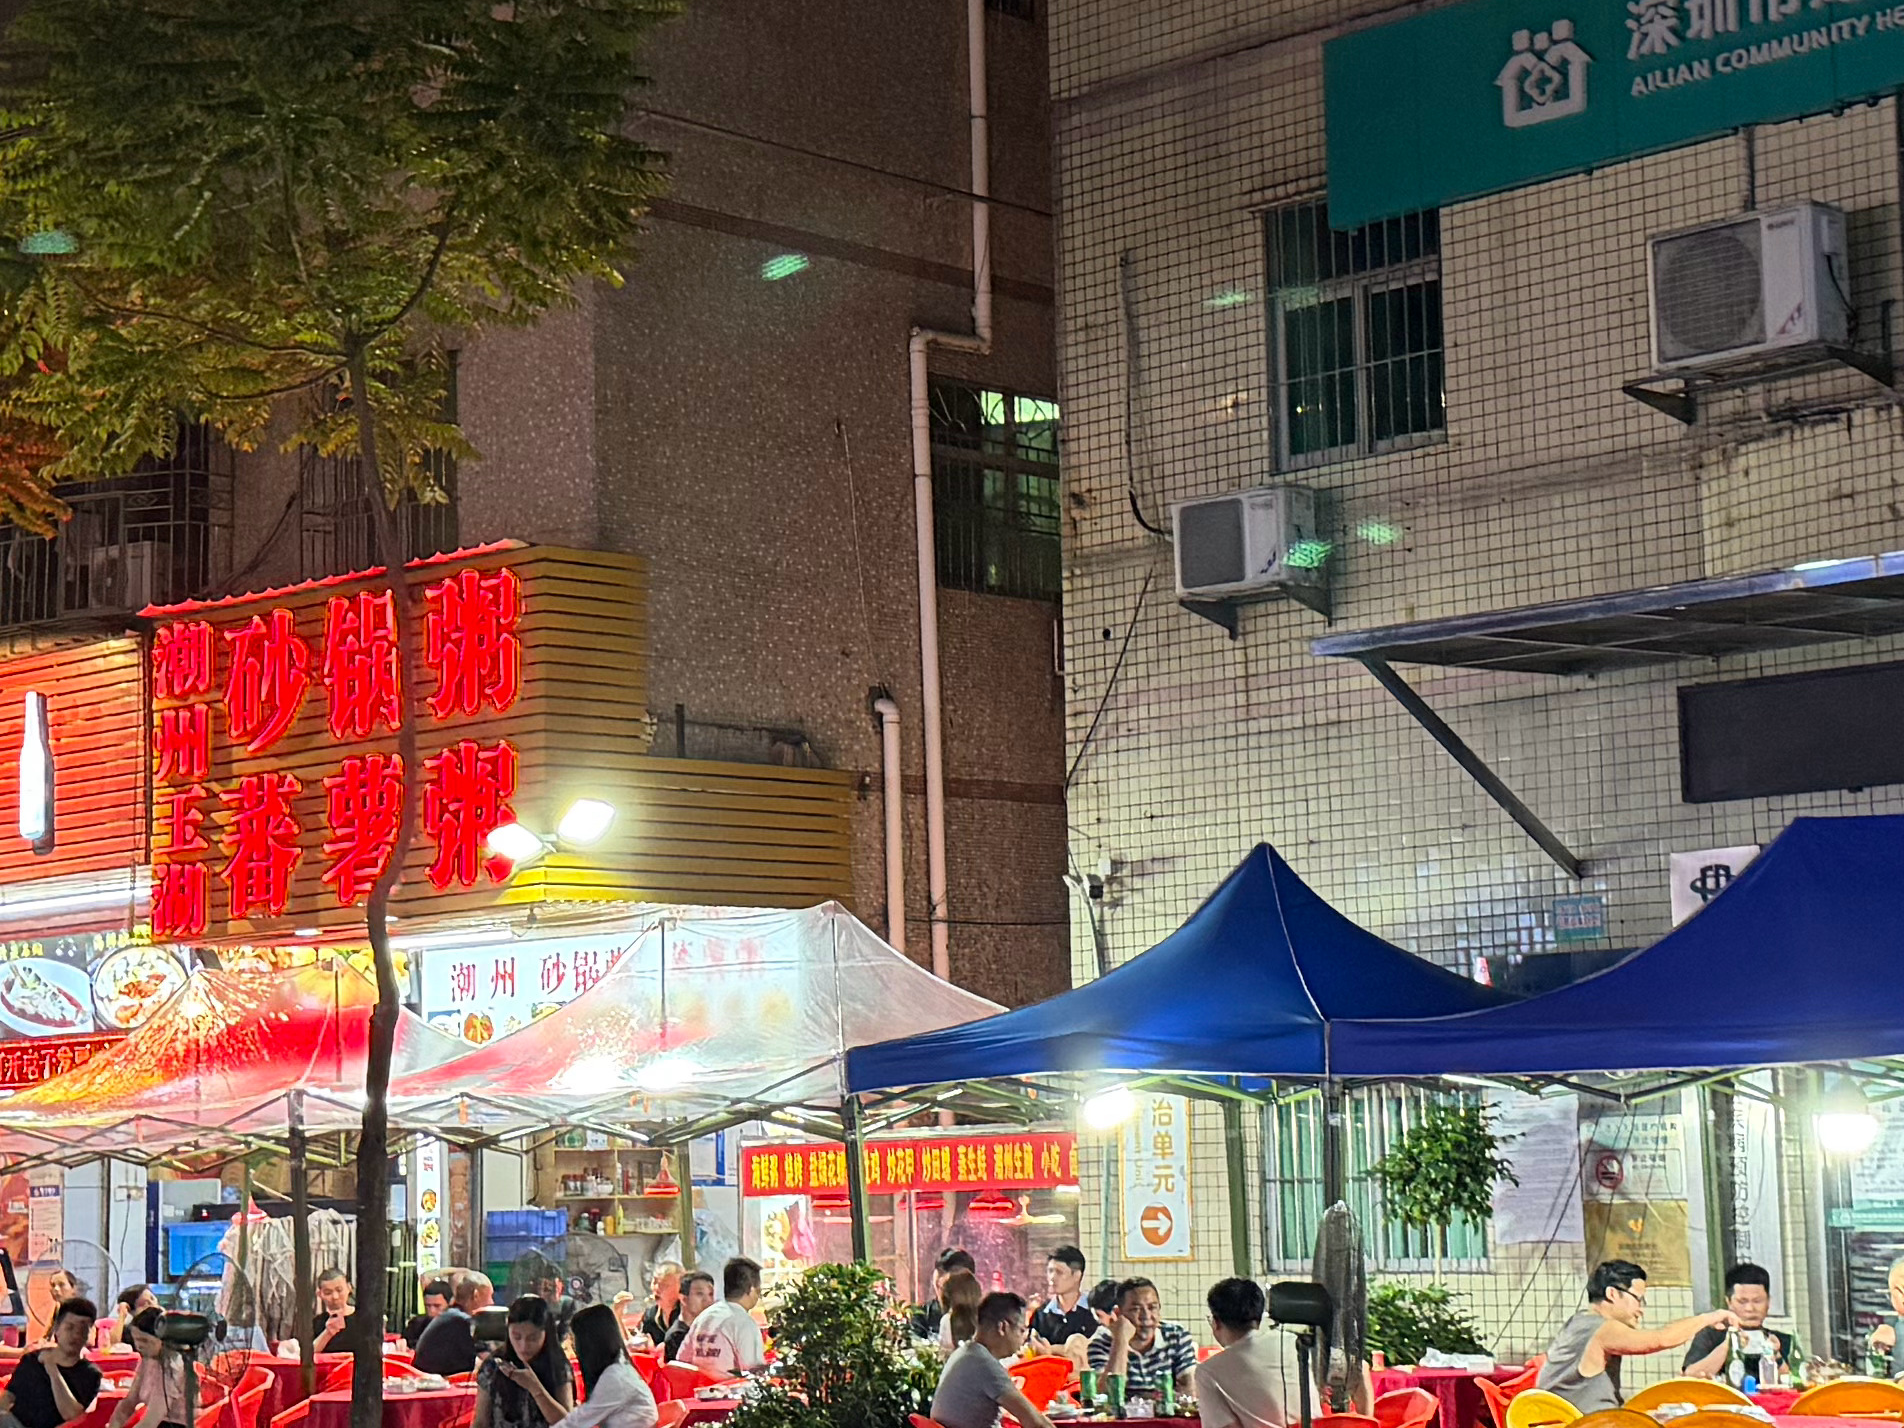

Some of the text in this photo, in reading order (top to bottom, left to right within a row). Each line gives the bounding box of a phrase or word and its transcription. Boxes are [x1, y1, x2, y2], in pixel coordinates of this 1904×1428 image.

[1630, 58, 1711, 97] AILIAN
[1715, 15, 1871, 73] COMMUNITY
[224, 566, 522, 754] 砂锅粥
[451, 956, 517, 1003] 潮州
[1152, 1097, 1176, 1194] 治单元
